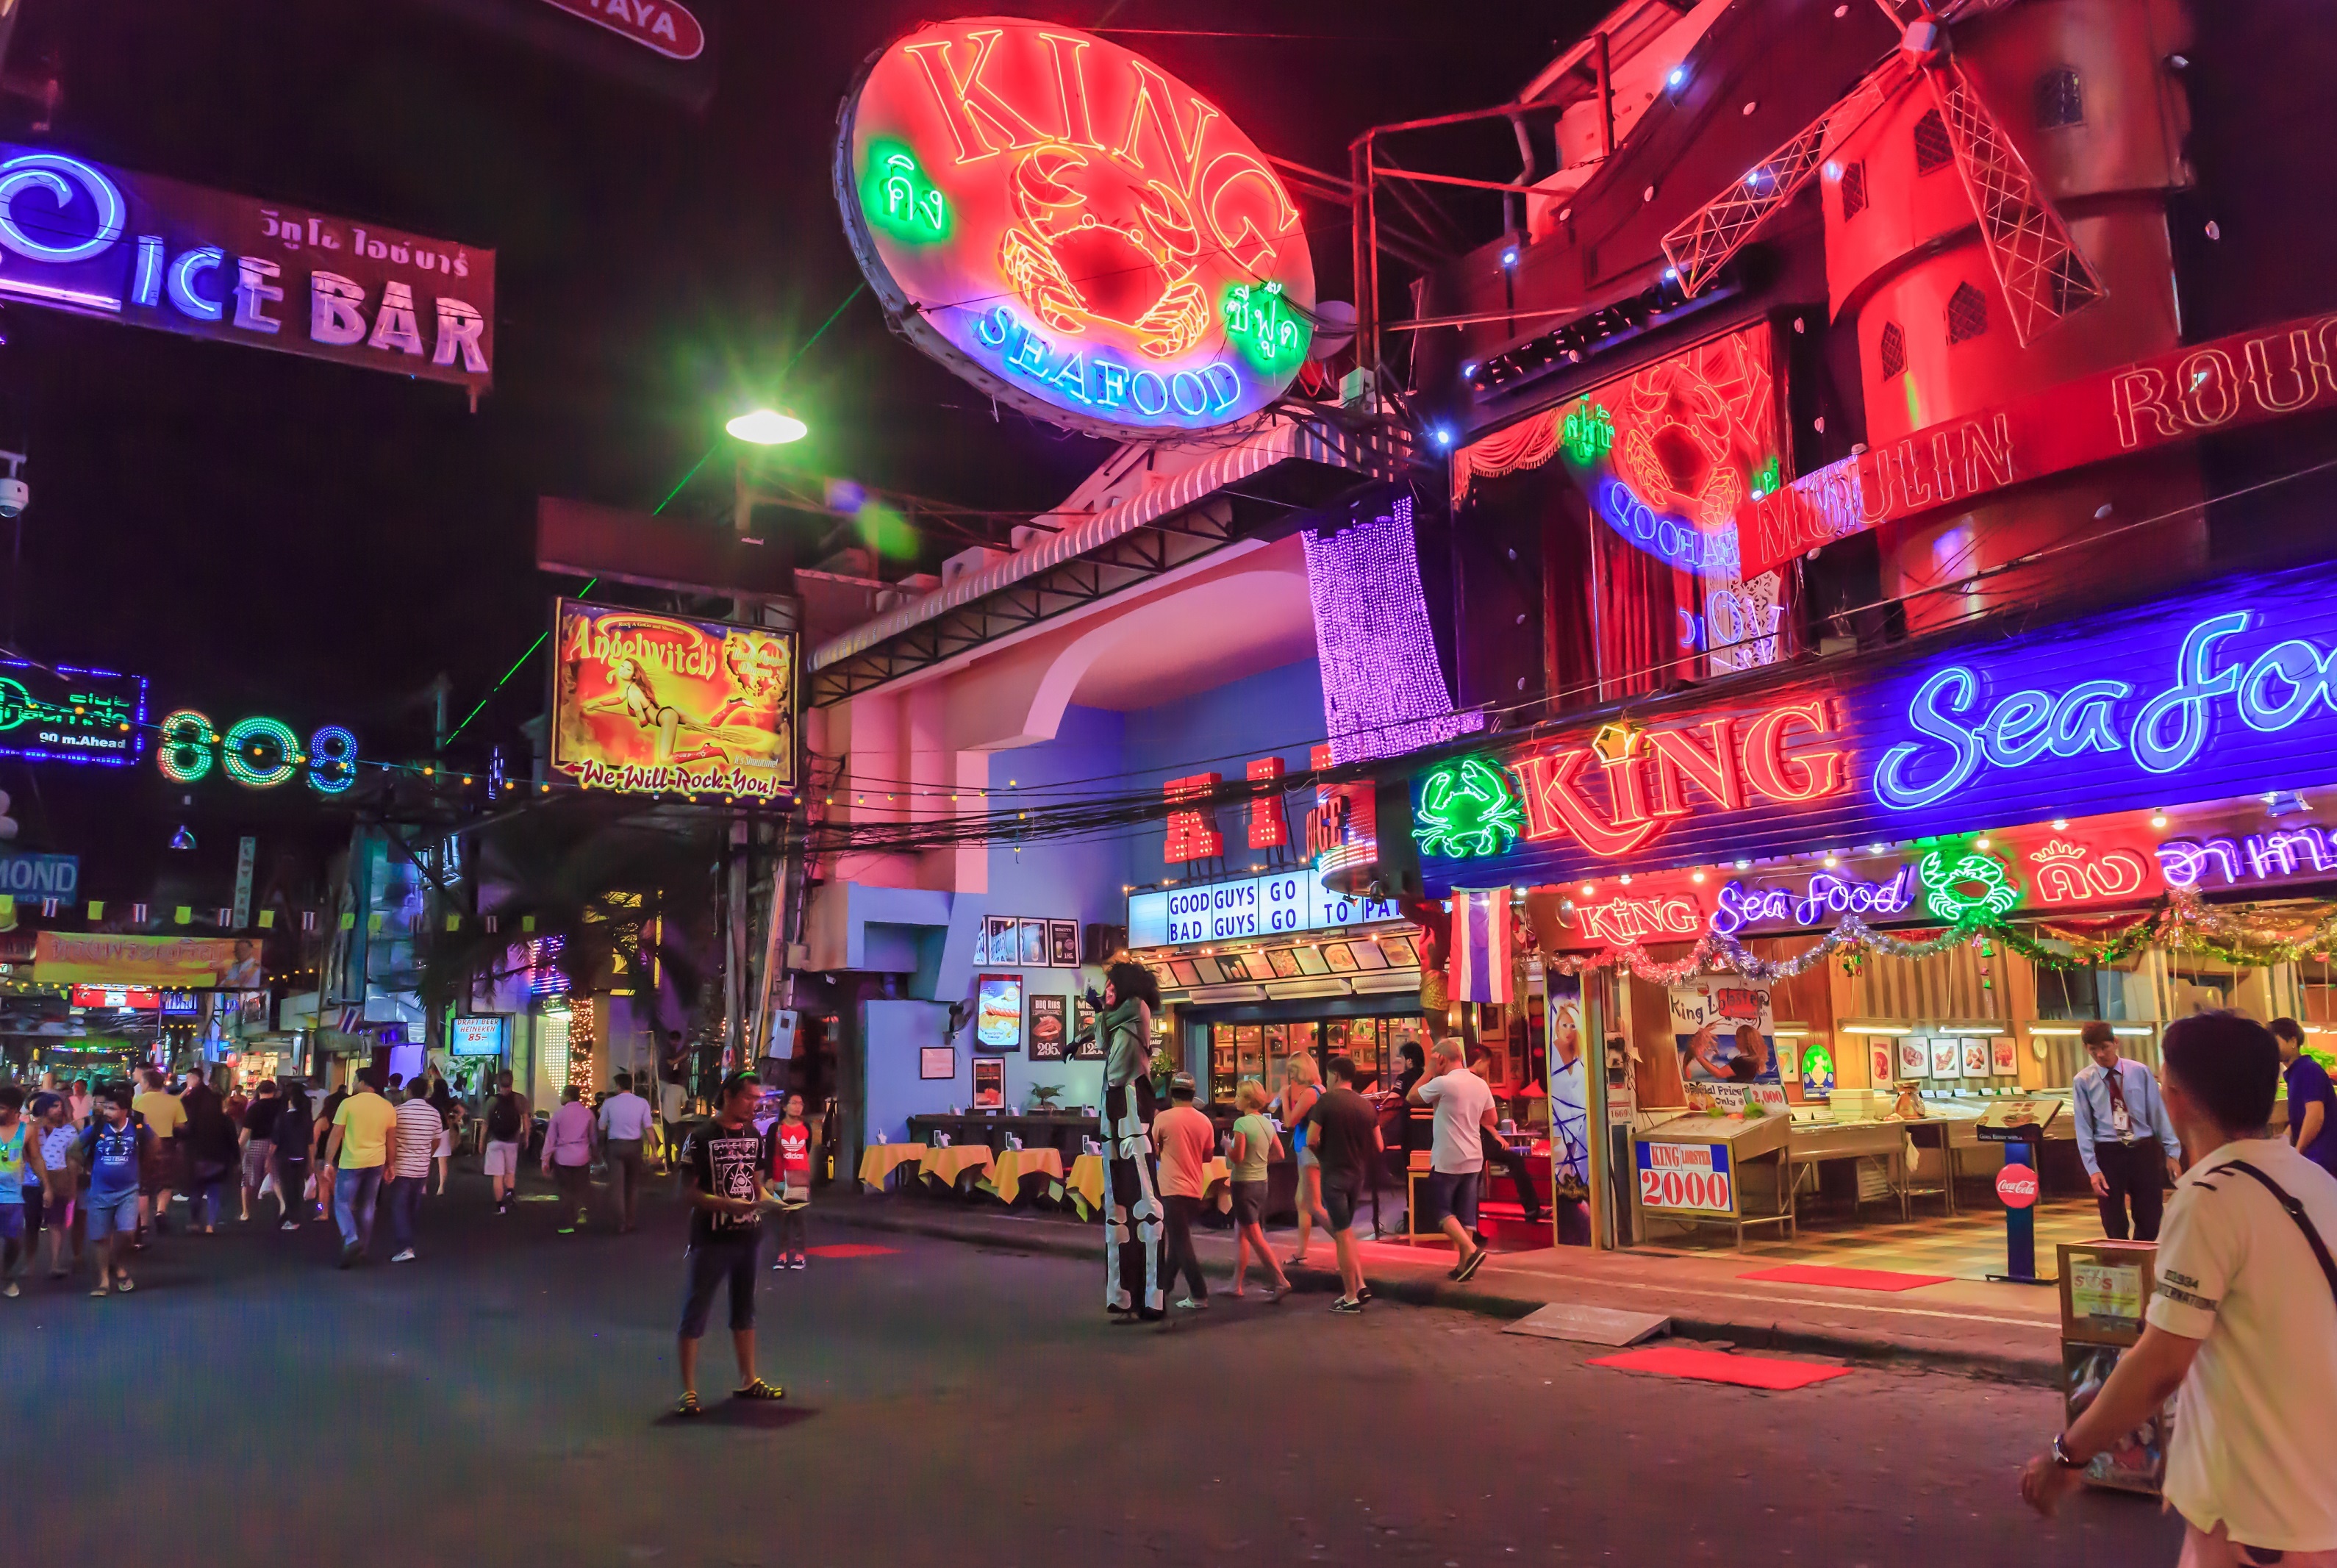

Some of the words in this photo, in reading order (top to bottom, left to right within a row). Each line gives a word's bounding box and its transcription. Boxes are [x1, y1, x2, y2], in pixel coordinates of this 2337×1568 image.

[590, 0, 676, 42] AYA
[906, 30, 1298, 271] KING
[888, 154, 942, 229] คิง
[131, 235, 284, 335] ICE
[310, 271, 489, 373] BAR
[980, 305, 1241, 416] SEAFOOD
[1761, 413, 2014, 565] MOULIN
[565, 615, 717, 684] Angelwitch
[157, 709, 359, 793] 808
[1874, 667, 2130, 810] Sea
[623, 765, 668, 790] Will
[675, 767, 723, 792] Rock
[731, 767, 777, 795] You!
[1170, 892, 1210, 914] GOOD
[1214, 886, 1256, 909] GUYS
[1270, 879, 1296, 902] GO
[1710, 887, 1786, 934] Sea
[1170, 920, 1203, 942] BAD
[1214, 913, 1256, 937] GUYS
[1271, 909, 1297, 930] GO
[1324, 901, 1348, 923] TO
[1035, 1000, 1047, 1010] BBQ
[1669, 995, 1704, 1025] King
[1717, 1085, 1742, 1096] Price
[1610, 1109, 1628, 1118] 1669
[1650, 1145, 1680, 1167] KING
[1681, 1150, 1711, 1166] LOBSTER
[1642, 1171, 1728, 1208] 2000
